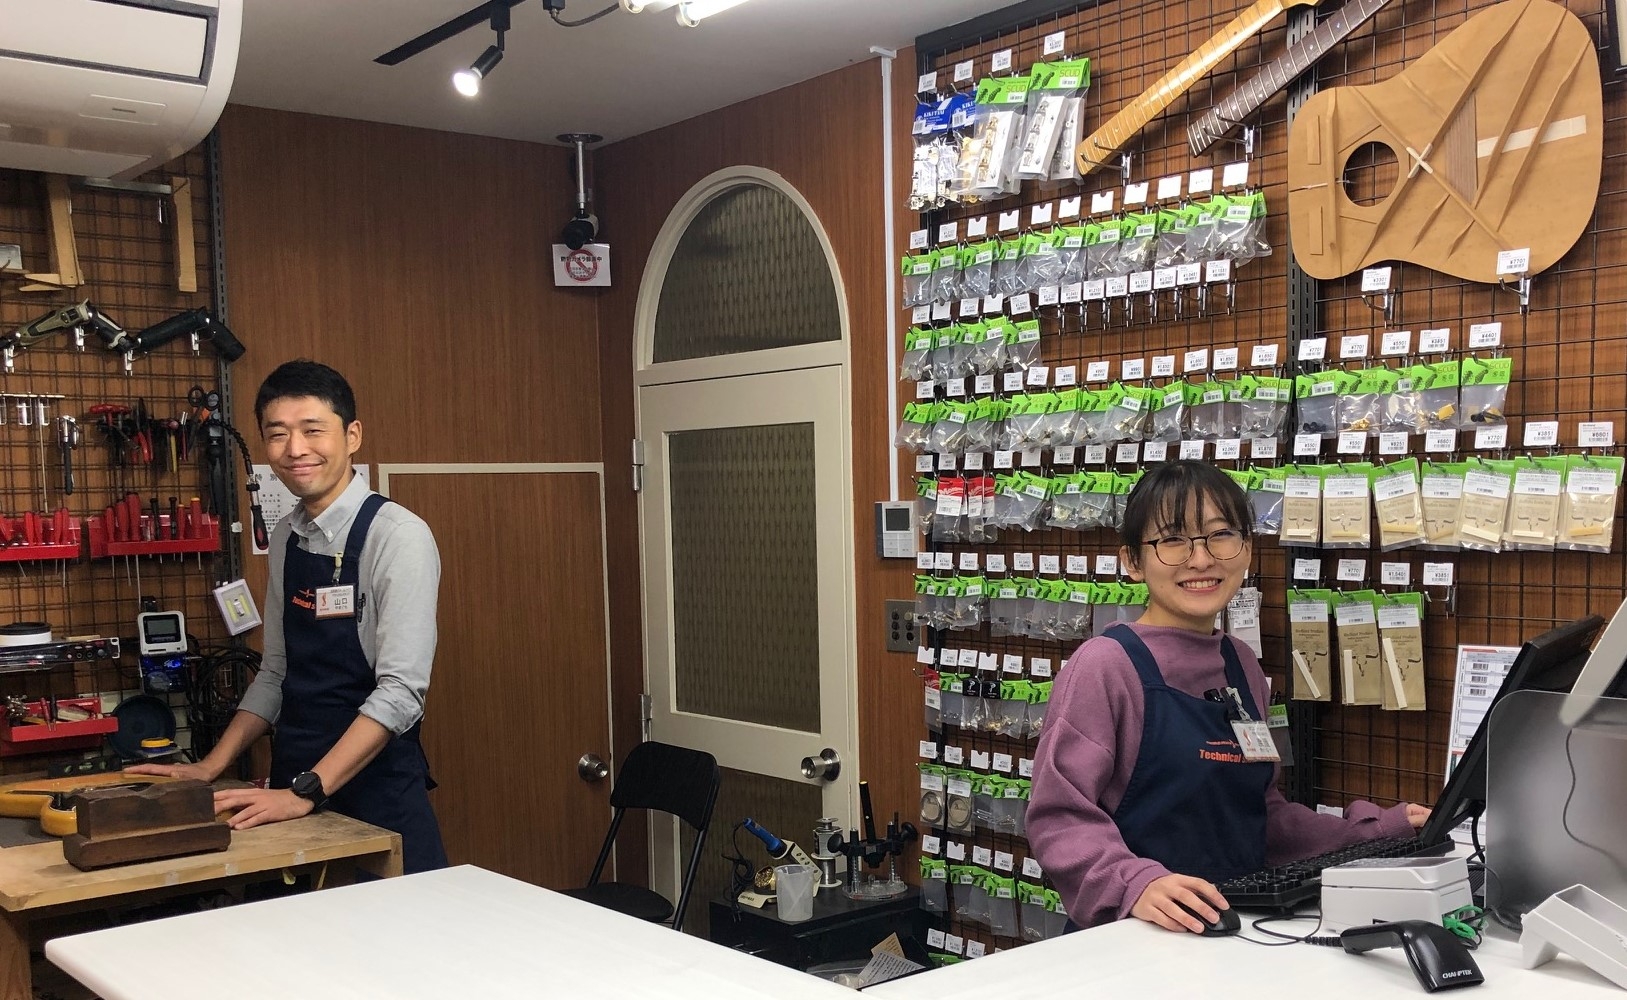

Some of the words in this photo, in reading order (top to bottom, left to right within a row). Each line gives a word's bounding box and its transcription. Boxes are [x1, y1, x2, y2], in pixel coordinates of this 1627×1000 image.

[1060, 69, 1080, 77] SCUD
[1006, 85, 1026, 93] SCUD
[1199, 749, 1241, 763] Technical
